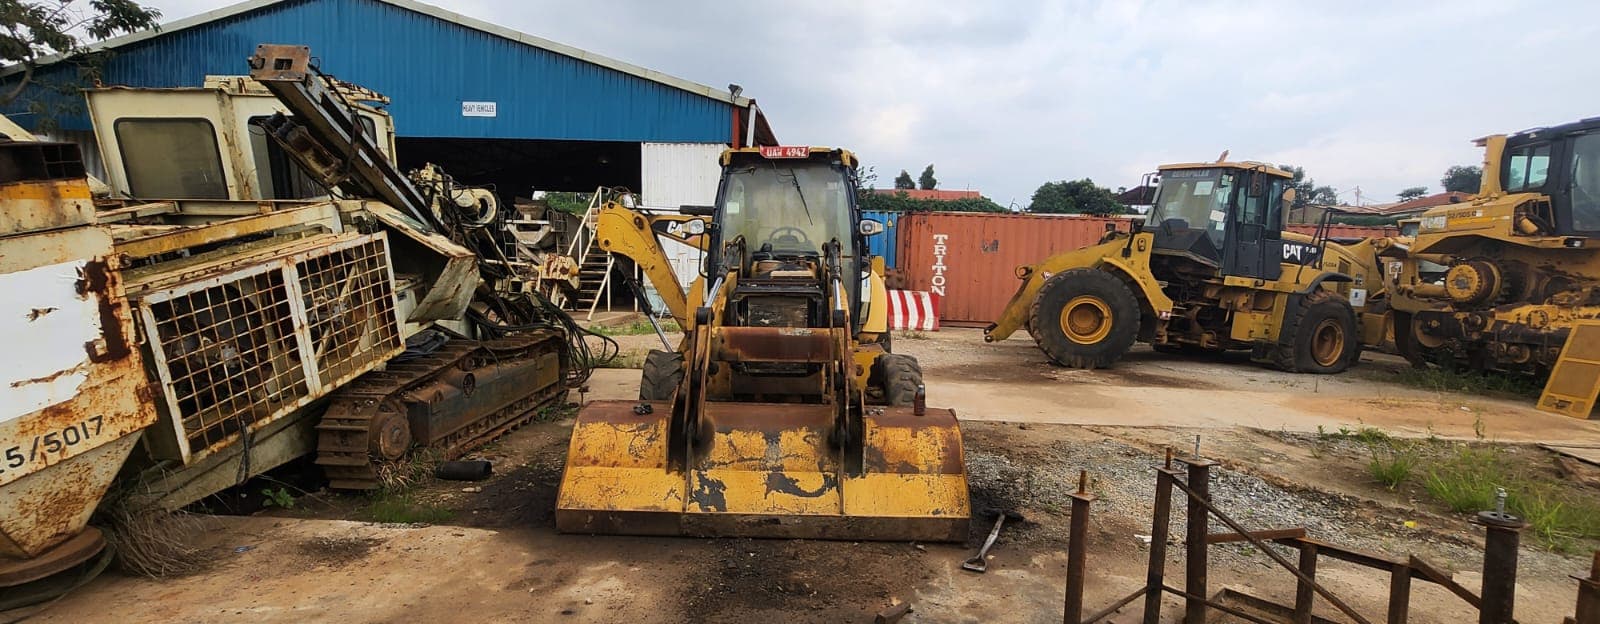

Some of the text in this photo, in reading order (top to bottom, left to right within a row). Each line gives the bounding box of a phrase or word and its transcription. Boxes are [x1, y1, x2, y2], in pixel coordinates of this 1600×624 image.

[463, 104, 495, 113] HEAVY VEHICLES
[786, 147, 806, 157] 494Z
[1283, 243, 1303, 261] CAT
[931, 234, 948, 297] TRITON
